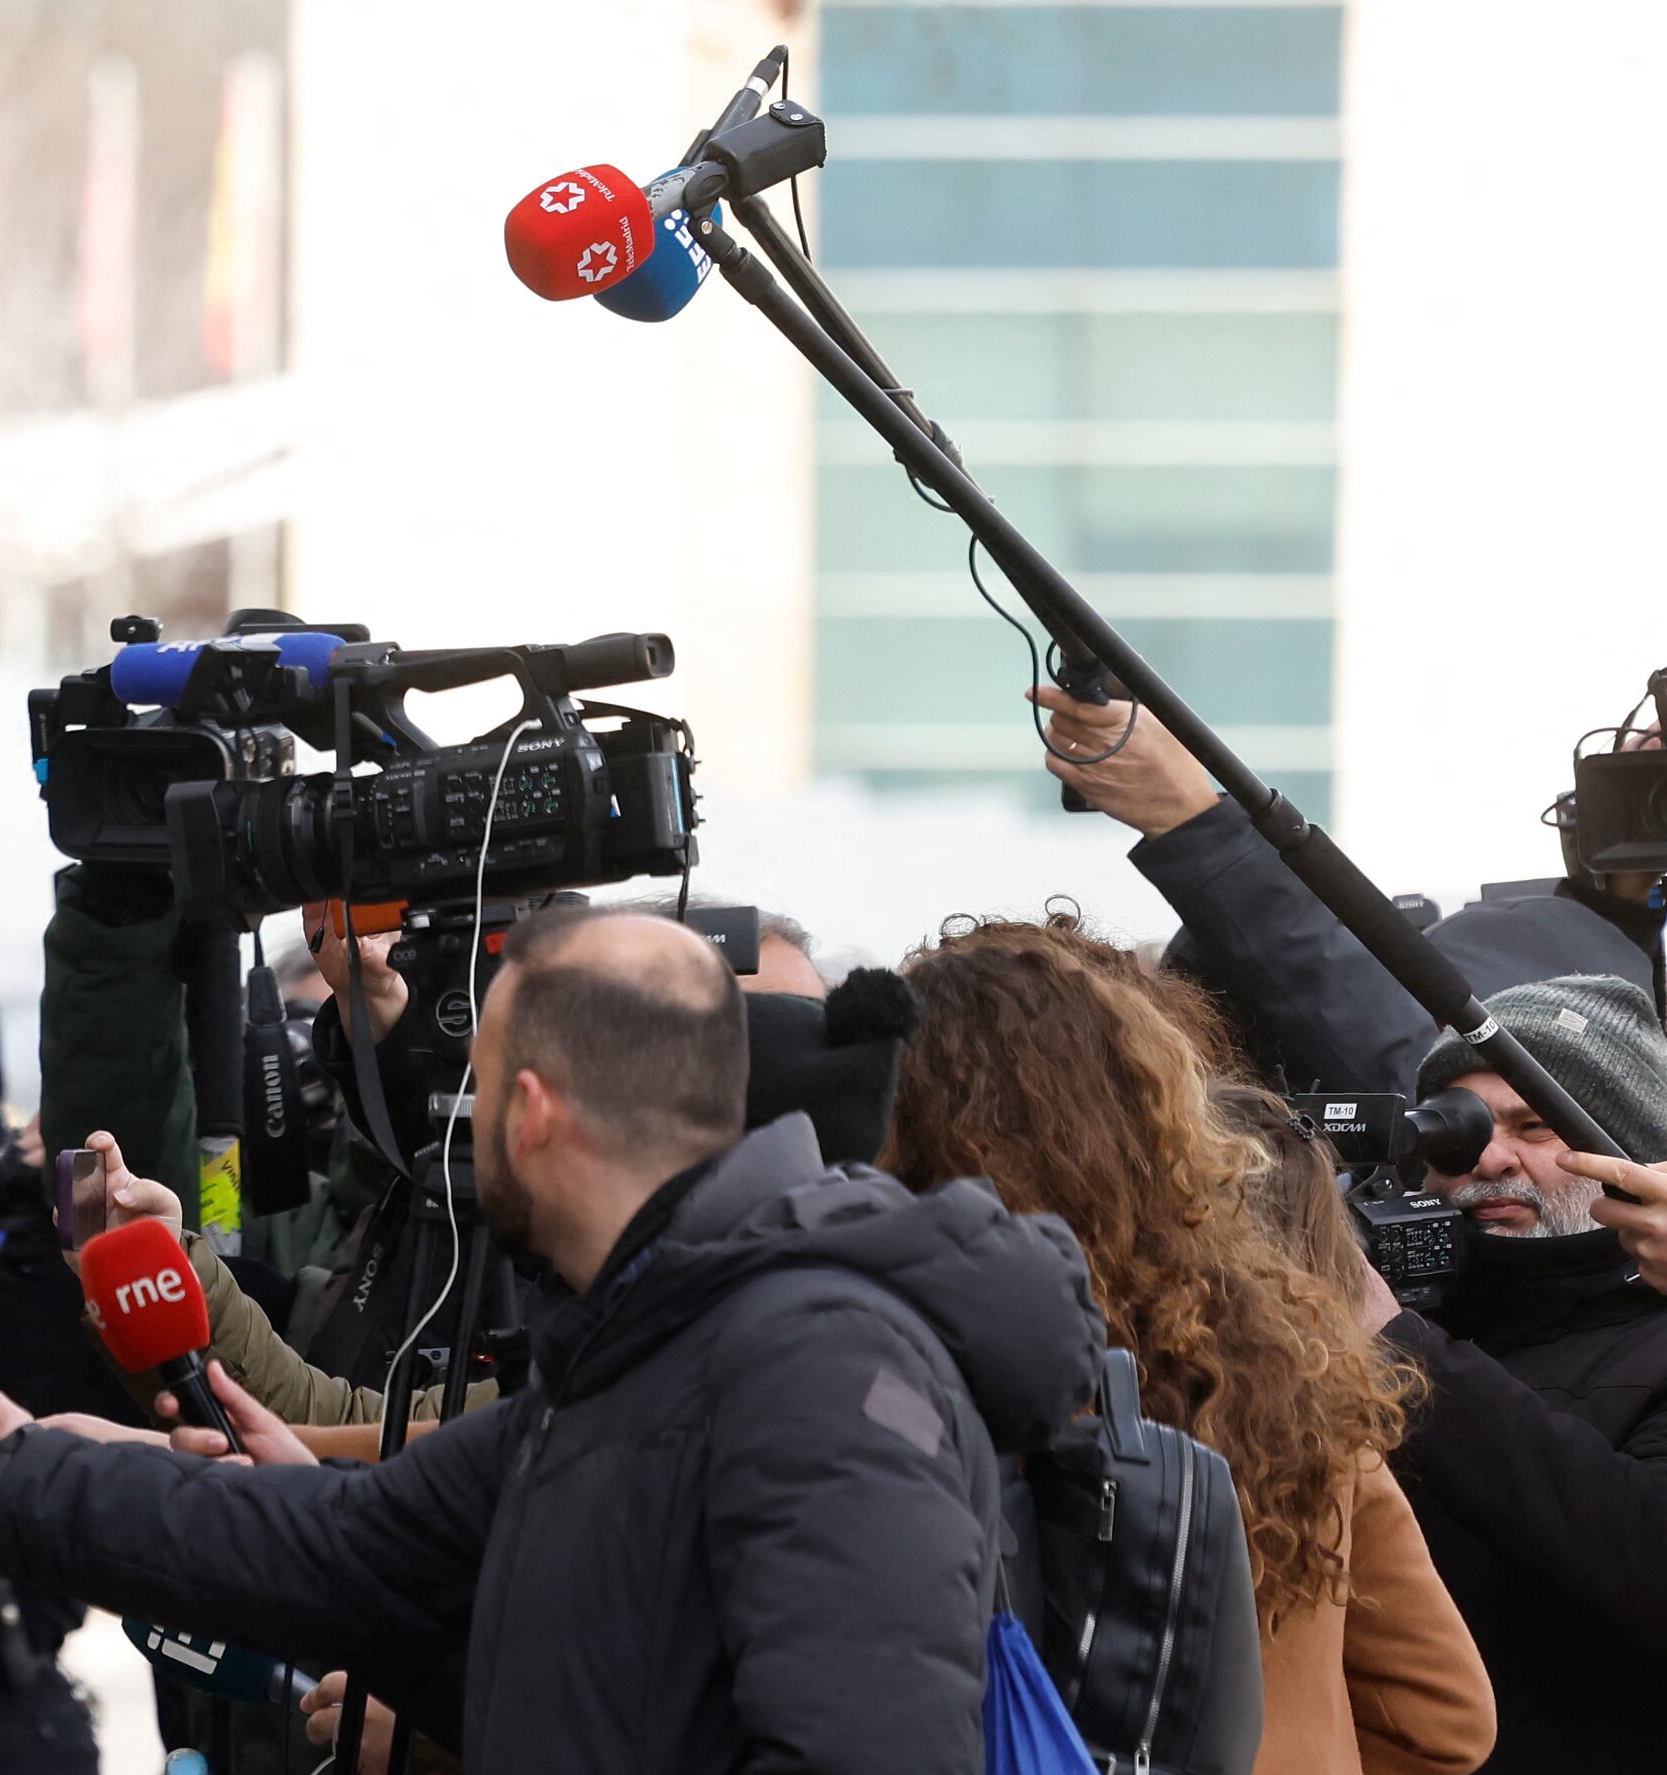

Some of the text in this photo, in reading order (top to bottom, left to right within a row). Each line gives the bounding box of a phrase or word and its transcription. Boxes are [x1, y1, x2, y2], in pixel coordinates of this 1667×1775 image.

[574, 168, 616, 203] TeleMadri
[619, 216, 635, 273] TeleMadrid
[517, 737, 566, 753] SONY
[1465, 1020, 1496, 1043] TM-10
[262, 1054, 286, 1138] Canon
[1328, 1106, 1354, 1116] TM-10
[1323, 1122, 1367, 1133] XDCAM
[1409, 1198, 1442, 1208] SONY
[115, 1267, 186, 1315] rne
[353, 1243, 382, 1313] SONY
